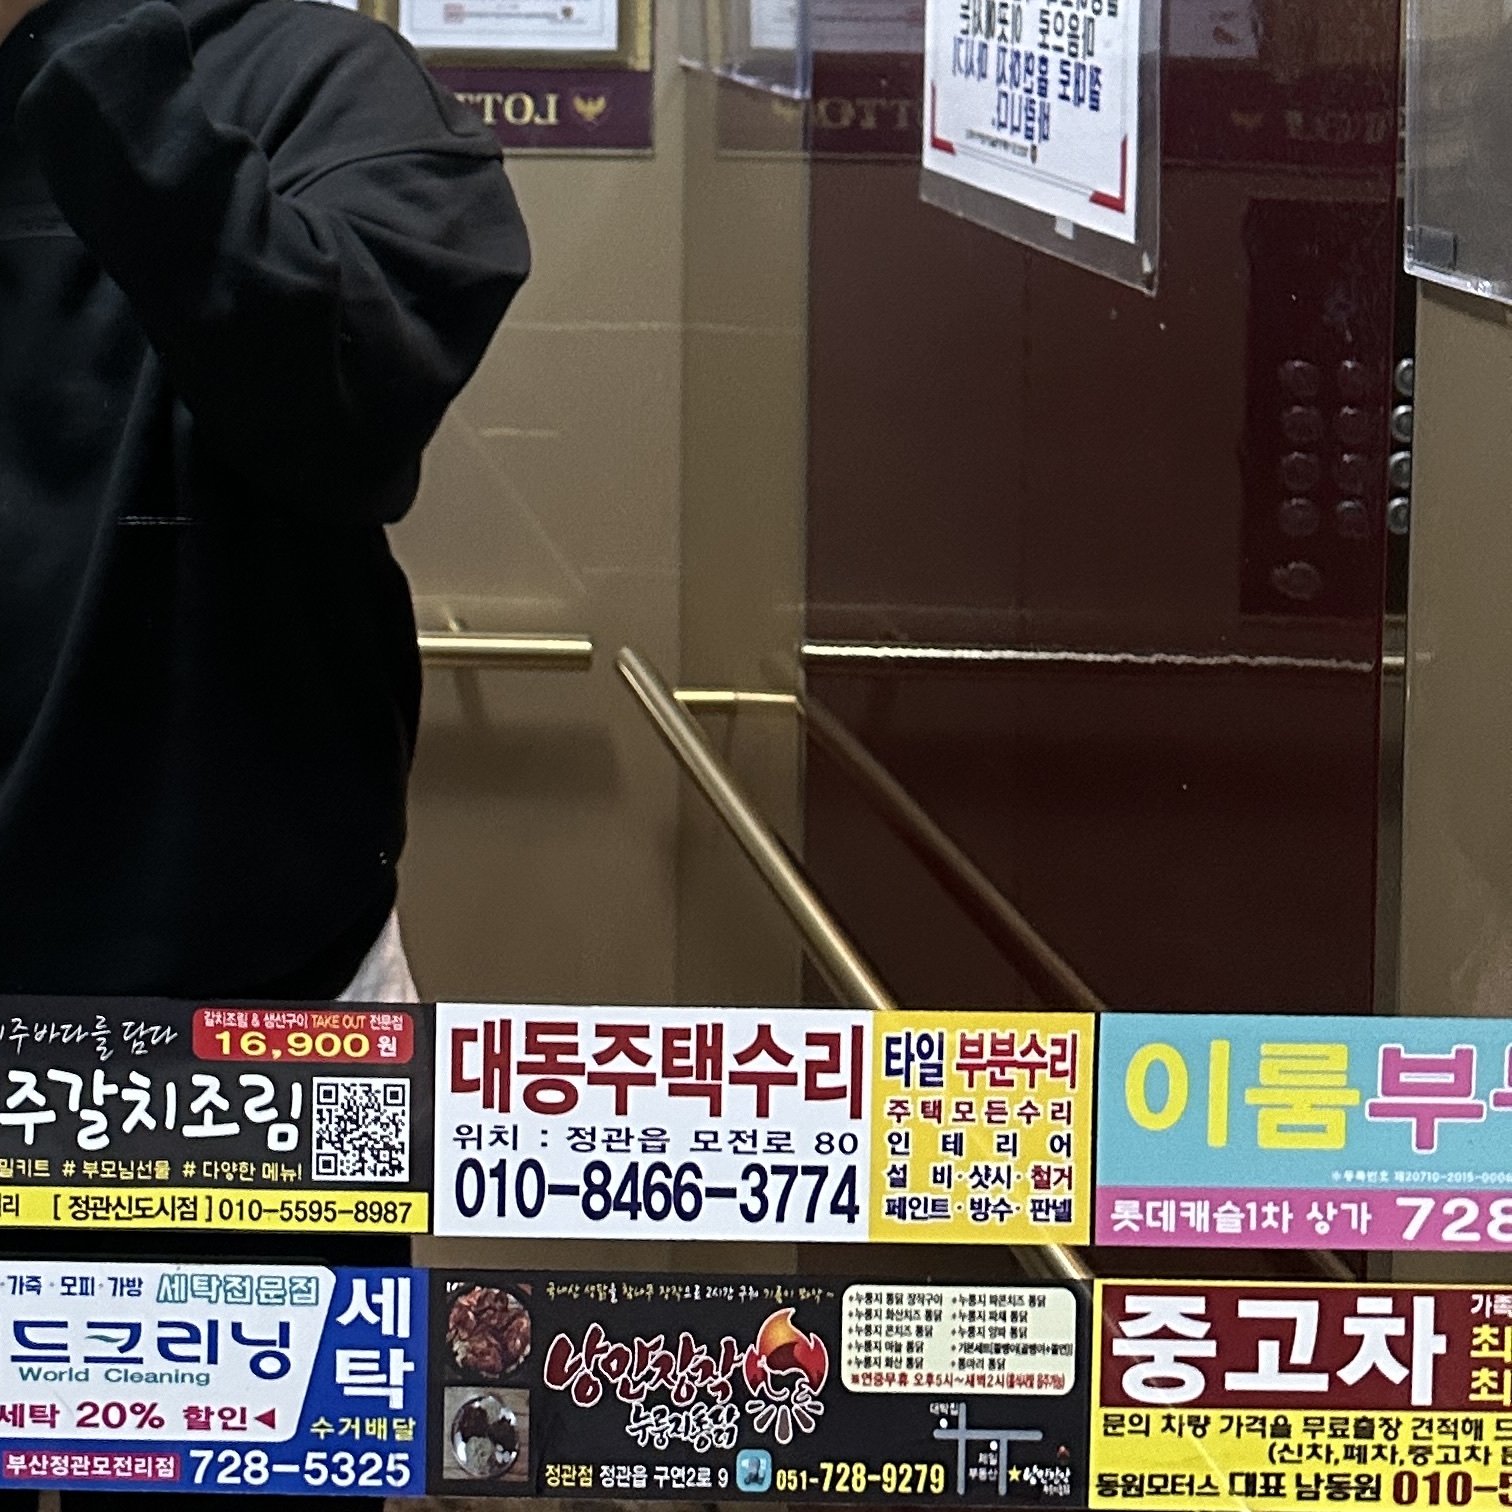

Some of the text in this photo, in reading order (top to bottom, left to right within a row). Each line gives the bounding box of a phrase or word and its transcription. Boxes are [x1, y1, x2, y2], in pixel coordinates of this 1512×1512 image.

[122, 1018, 179, 1054] 담다
[251, 1013, 260, 1028] &
[263, 1013, 308, 1030] 생선구이
[311, 1014, 340, 1029] TAKE
[342, 1015, 366, 1029] OUT
[369, 1015, 404, 1031] 전문점
[215, 1031, 397, 1060] 16,900 원
[885, 1031, 1079, 1091] 타일 부분수리
[450, 1018, 865, 1120] 대동주택수리
[452, 1123, 860, 1156] 위치 정관읍 모전로 80
[82, 1160, 170, 1181] 부모님선물
[202, 1161, 257, 1182] 다양한
[262, 1162, 303, 1182] 메뉴!
[453, 1157, 861, 1225] 010-8466-3774
[68, 1195, 198, 1221] 정관신도시점
[218, 1198, 413, 1224] 010-5595-8987
[885, 1196, 1073, 1223] 페인트 방수 판넬
[1110, 1199, 1372, 1236] 롯데캐슬1차 상가
[6, 1274, 43, 1296] 가죽
[60, 1275, 95, 1296] 모피
[106, 1276, 144, 1297] 가방
[155, 1273, 321, 1306] 세탁전문점
[1112, 1294, 1448, 1407] 중고차
[19, 1365, 211, 1387] World Cleaning
[75, 1401, 166, 1430] 20%
[182, 1403, 248, 1433] 할인
[309, 1415, 418, 1443] 수거배달
[1102, 1413, 1484, 1442] 문의 차량 가격을 무료출장 견적해
[5, 1453, 176, 1479] 부산정관모전리점
[189, 1448, 413, 1488] 728-5325
[544, 1462, 945, 1494] 정관점 정관읍 구연2로 9 051-728-9279
[1095, 1471, 1219, 1499] 동원모터스
[1229, 1472, 1286, 1499] 대표
[1295, 1472, 1382, 1502] 남동원
